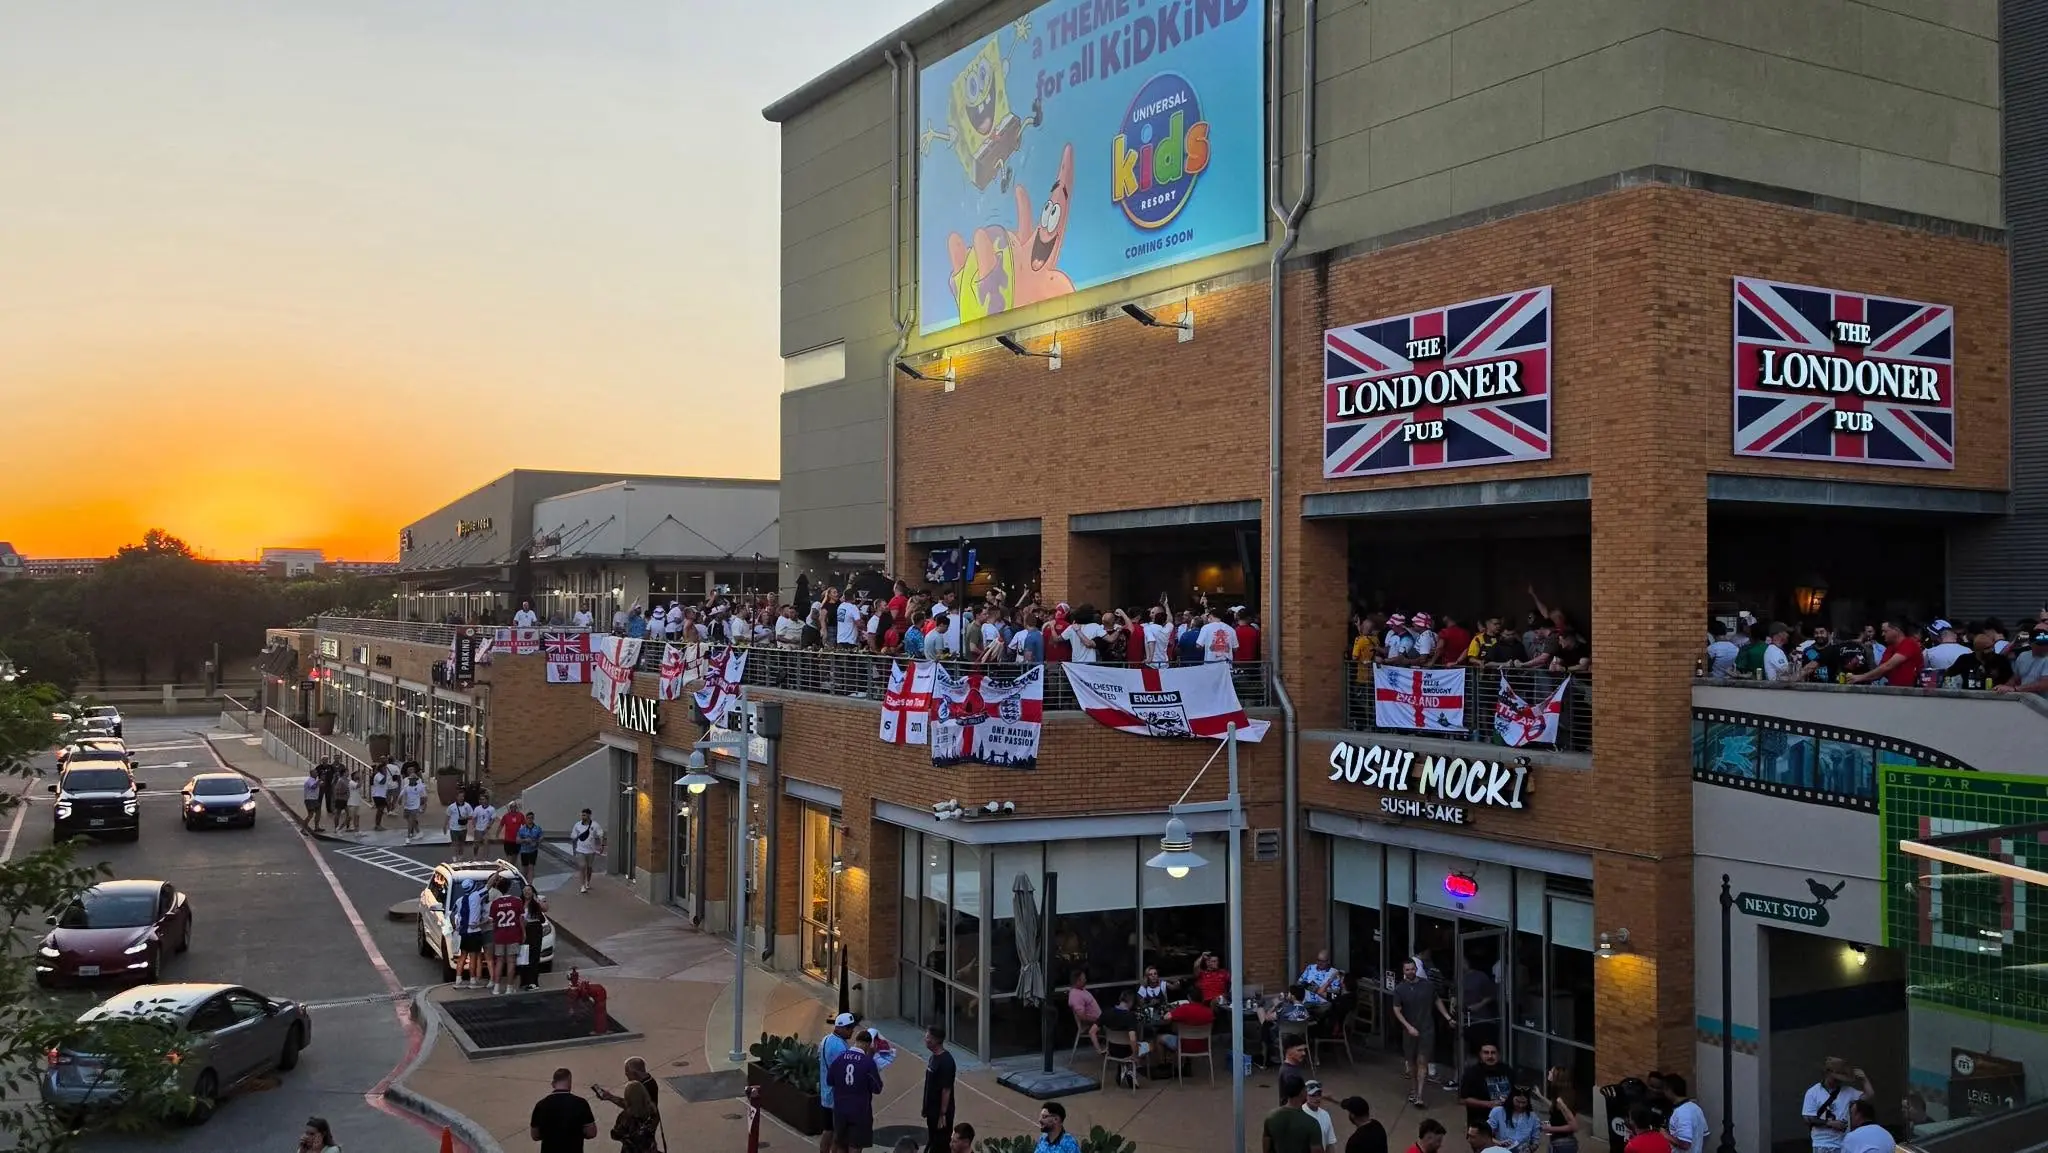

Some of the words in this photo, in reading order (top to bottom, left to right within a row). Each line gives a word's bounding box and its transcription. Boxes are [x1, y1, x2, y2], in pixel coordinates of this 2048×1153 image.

[1032, 37, 1042, 59] a
[1047, 0, 1130, 50] THEME
[1036, 69, 1065, 99] for
[1069, 41, 1094, 88] all
[1133, 91, 1188, 123] UNIVERSAL
[1112, 111, 1211, 201] kids
[1141, 190, 1176, 210] RESORT
[1125, 239, 1162, 259] COMING
[1166, 228, 1193, 247] SOON
[1837, 321, 1871, 344] THE
[1406, 337, 1441, 359] THE
[1762, 350, 1940, 401] LONDONER
[1337, 360, 1521, 417] LONDONER
[1403, 421, 1443, 442] PUB
[1835, 411, 1874, 432] PUB
[1133, 693, 1178, 703] ENGLAND
[1396, 692, 1440, 708] ENGLAND
[617, 694, 657, 735] MANE
[989, 736, 1002, 744] ONE
[992, 726, 1006, 734] ONE
[1008, 727, 1033, 738] NATION
[1328, 741, 1414, 791] SUSHI
[496, 909, 516, 927] 22
[1745, 898, 1780, 915] NEXT
[1783, 903, 1817, 920] STOP
[845, 1064, 855, 1086] 8
[1967, 1088, 1993, 1105] LEVEL
